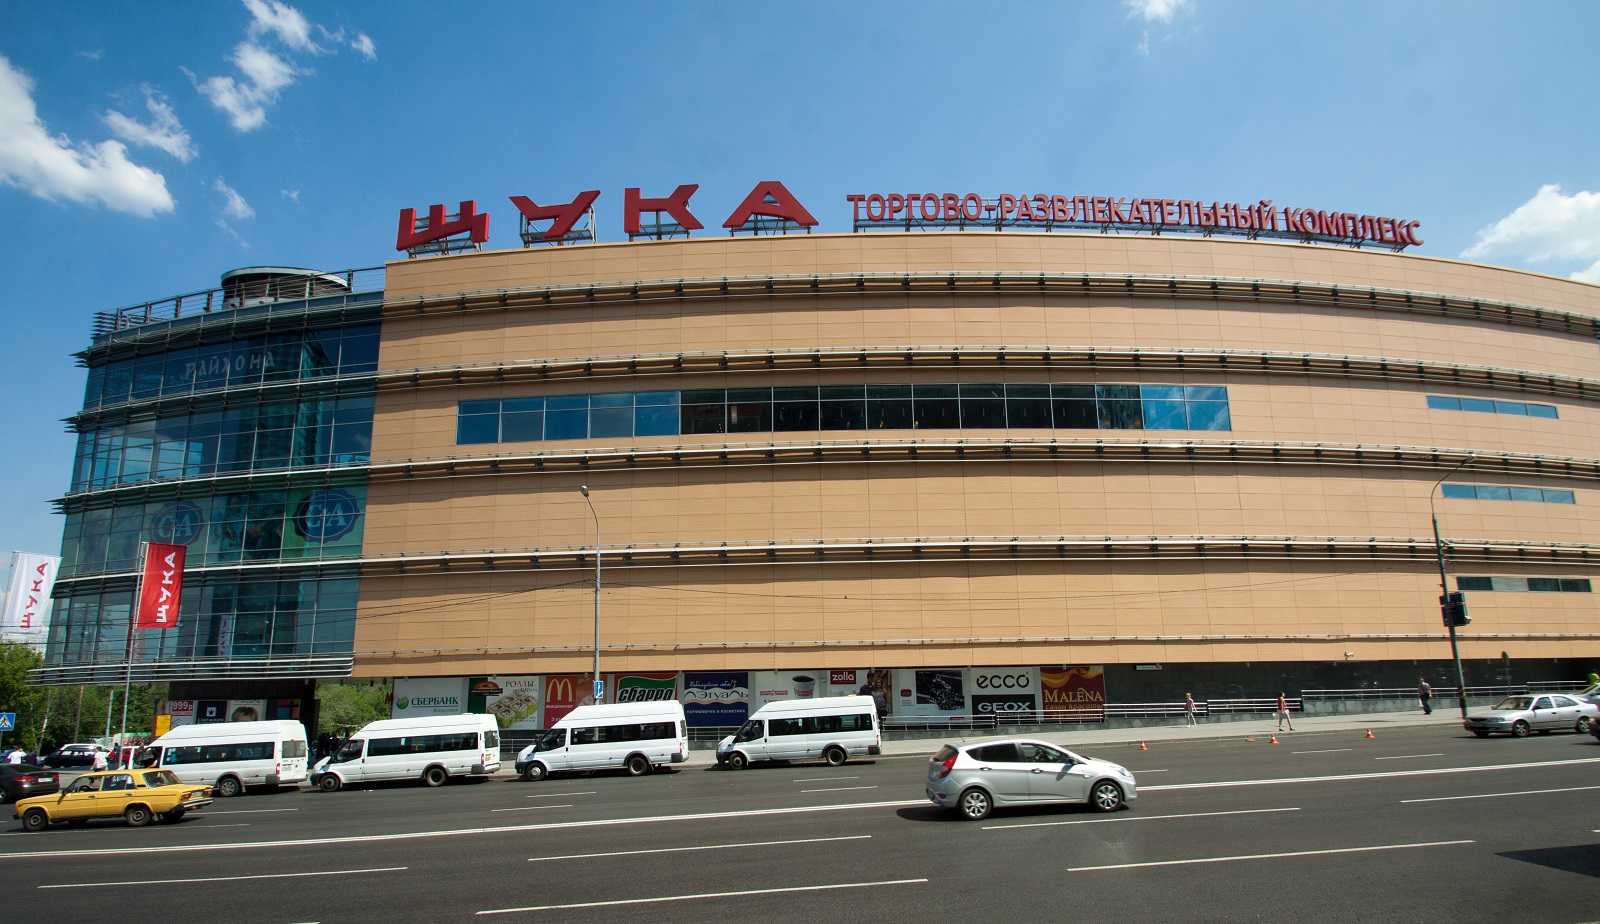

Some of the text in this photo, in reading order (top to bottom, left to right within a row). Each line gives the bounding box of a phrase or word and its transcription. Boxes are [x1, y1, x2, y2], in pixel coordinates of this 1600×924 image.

[396, 181, 819, 251] ЩУКА
[847, 193, 1424, 246] ТОРГОВО-РАЗВЛЕКАТЕЛЬНЫЙ КОМПЛЕКС
[832, 671, 855, 681] zolla
[505, 680, 534, 688] РОЛЛЫ
[411, 696, 459, 706] СБЕРБАНК
[977, 702, 1031, 712] GEOX
